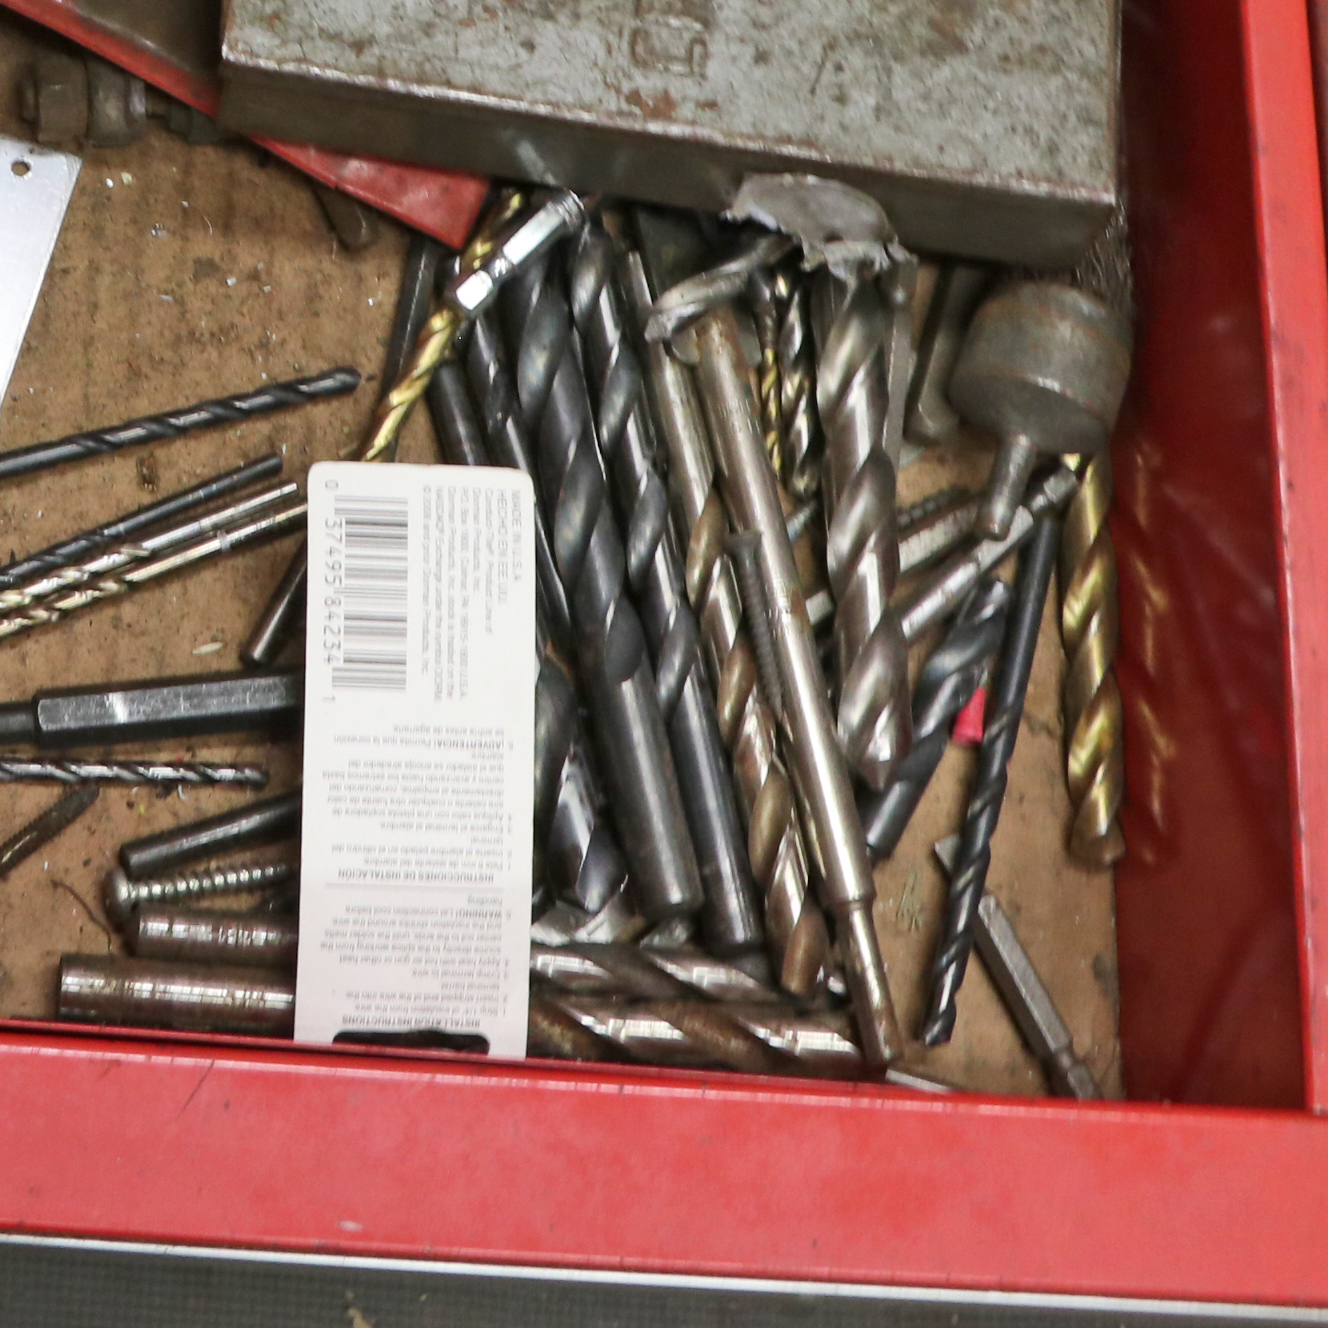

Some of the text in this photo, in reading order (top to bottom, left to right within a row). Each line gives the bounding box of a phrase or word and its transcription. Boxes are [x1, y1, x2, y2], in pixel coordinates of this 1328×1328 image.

[511, 490, 521, 526] MADE
[497, 489, 507, 557] HECHO EN
[512, 534, 521, 543] IN
[323, 480, 342, 703] 0 37495 84234 1
[403, 870, 415, 880] DE
[342, 1015, 480, 1028] INSTALLATION INSTRUCTIONS
